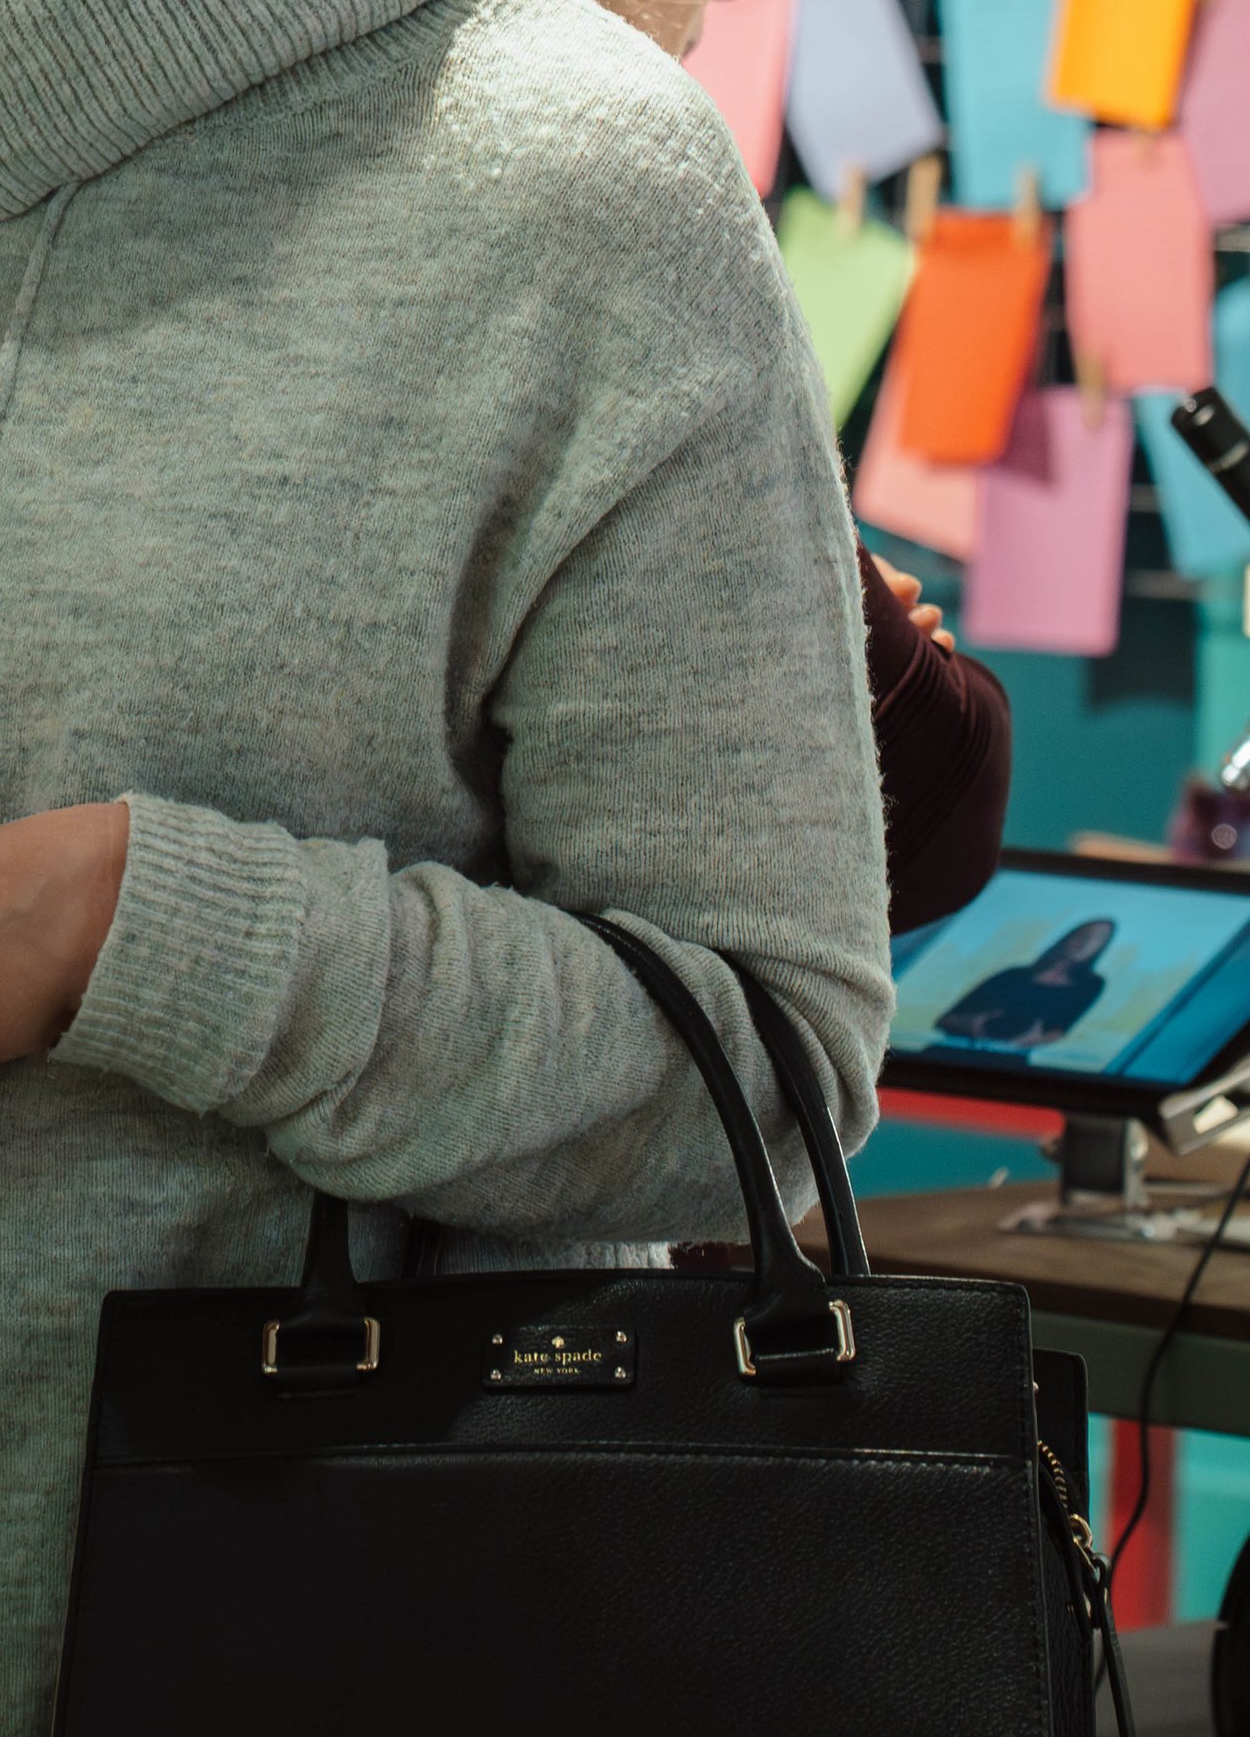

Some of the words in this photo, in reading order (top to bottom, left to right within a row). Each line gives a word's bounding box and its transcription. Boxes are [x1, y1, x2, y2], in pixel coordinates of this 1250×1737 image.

[513, 1349, 549, 1364] kate
[554, 1348, 602, 1366] spade
[533, 1367, 552, 1375] NEW
[556, 1367, 580, 1375] YORK
